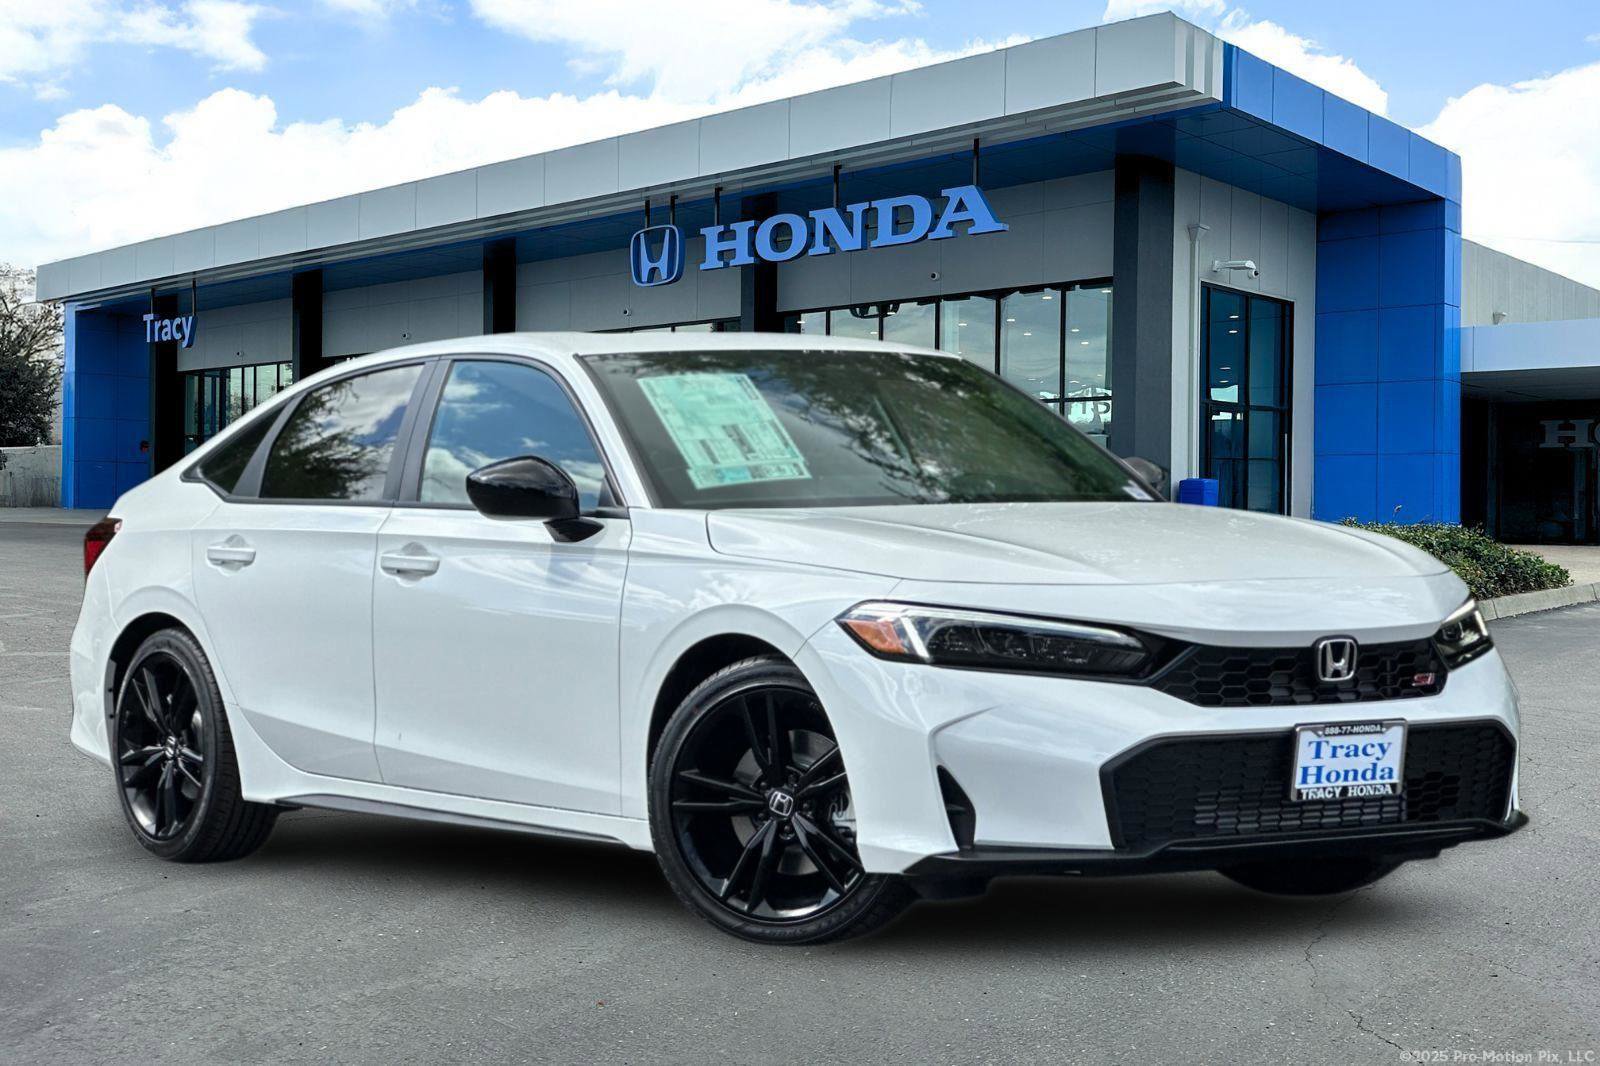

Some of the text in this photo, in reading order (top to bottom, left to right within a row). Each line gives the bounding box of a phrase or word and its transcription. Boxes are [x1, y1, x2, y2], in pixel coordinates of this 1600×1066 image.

[700, 185, 1009, 271] HONDA
[143, 313, 193, 348] Tracy
[1539, 419, 1600, 448] H
[1308, 739, 1393, 761] Tracy
[1299, 762, 1394, 785] Honda
[1301, 784, 1393, 800] TRACY HONDA
